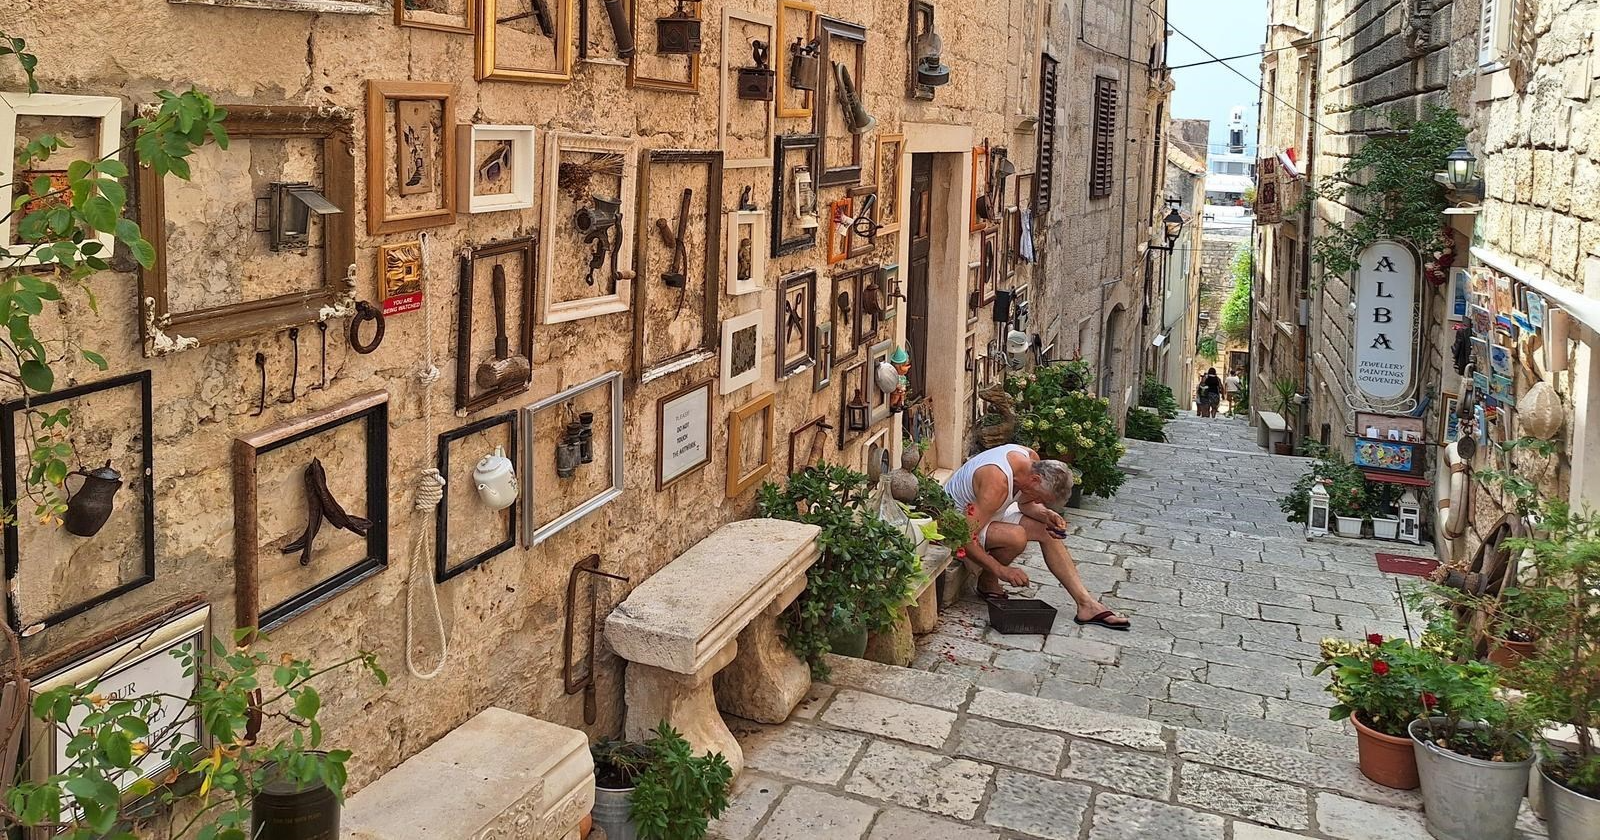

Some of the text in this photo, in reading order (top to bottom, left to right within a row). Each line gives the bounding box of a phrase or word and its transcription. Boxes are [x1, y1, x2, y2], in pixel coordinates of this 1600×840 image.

[398, 302, 420, 311] WATCHED
[1370, 256, 1399, 351] ALBA
[1359, 361, 1405, 370] JEWELLERY
[1359, 368, 1405, 378] PAINTINGS
[1358, 375, 1405, 385] SOUVENIRS
[676, 411, 689, 421] PLEASE
[677, 425, 682, 433] DO
[676, 434, 688, 443] TOUCH
[104, 682, 136, 705] OUR
